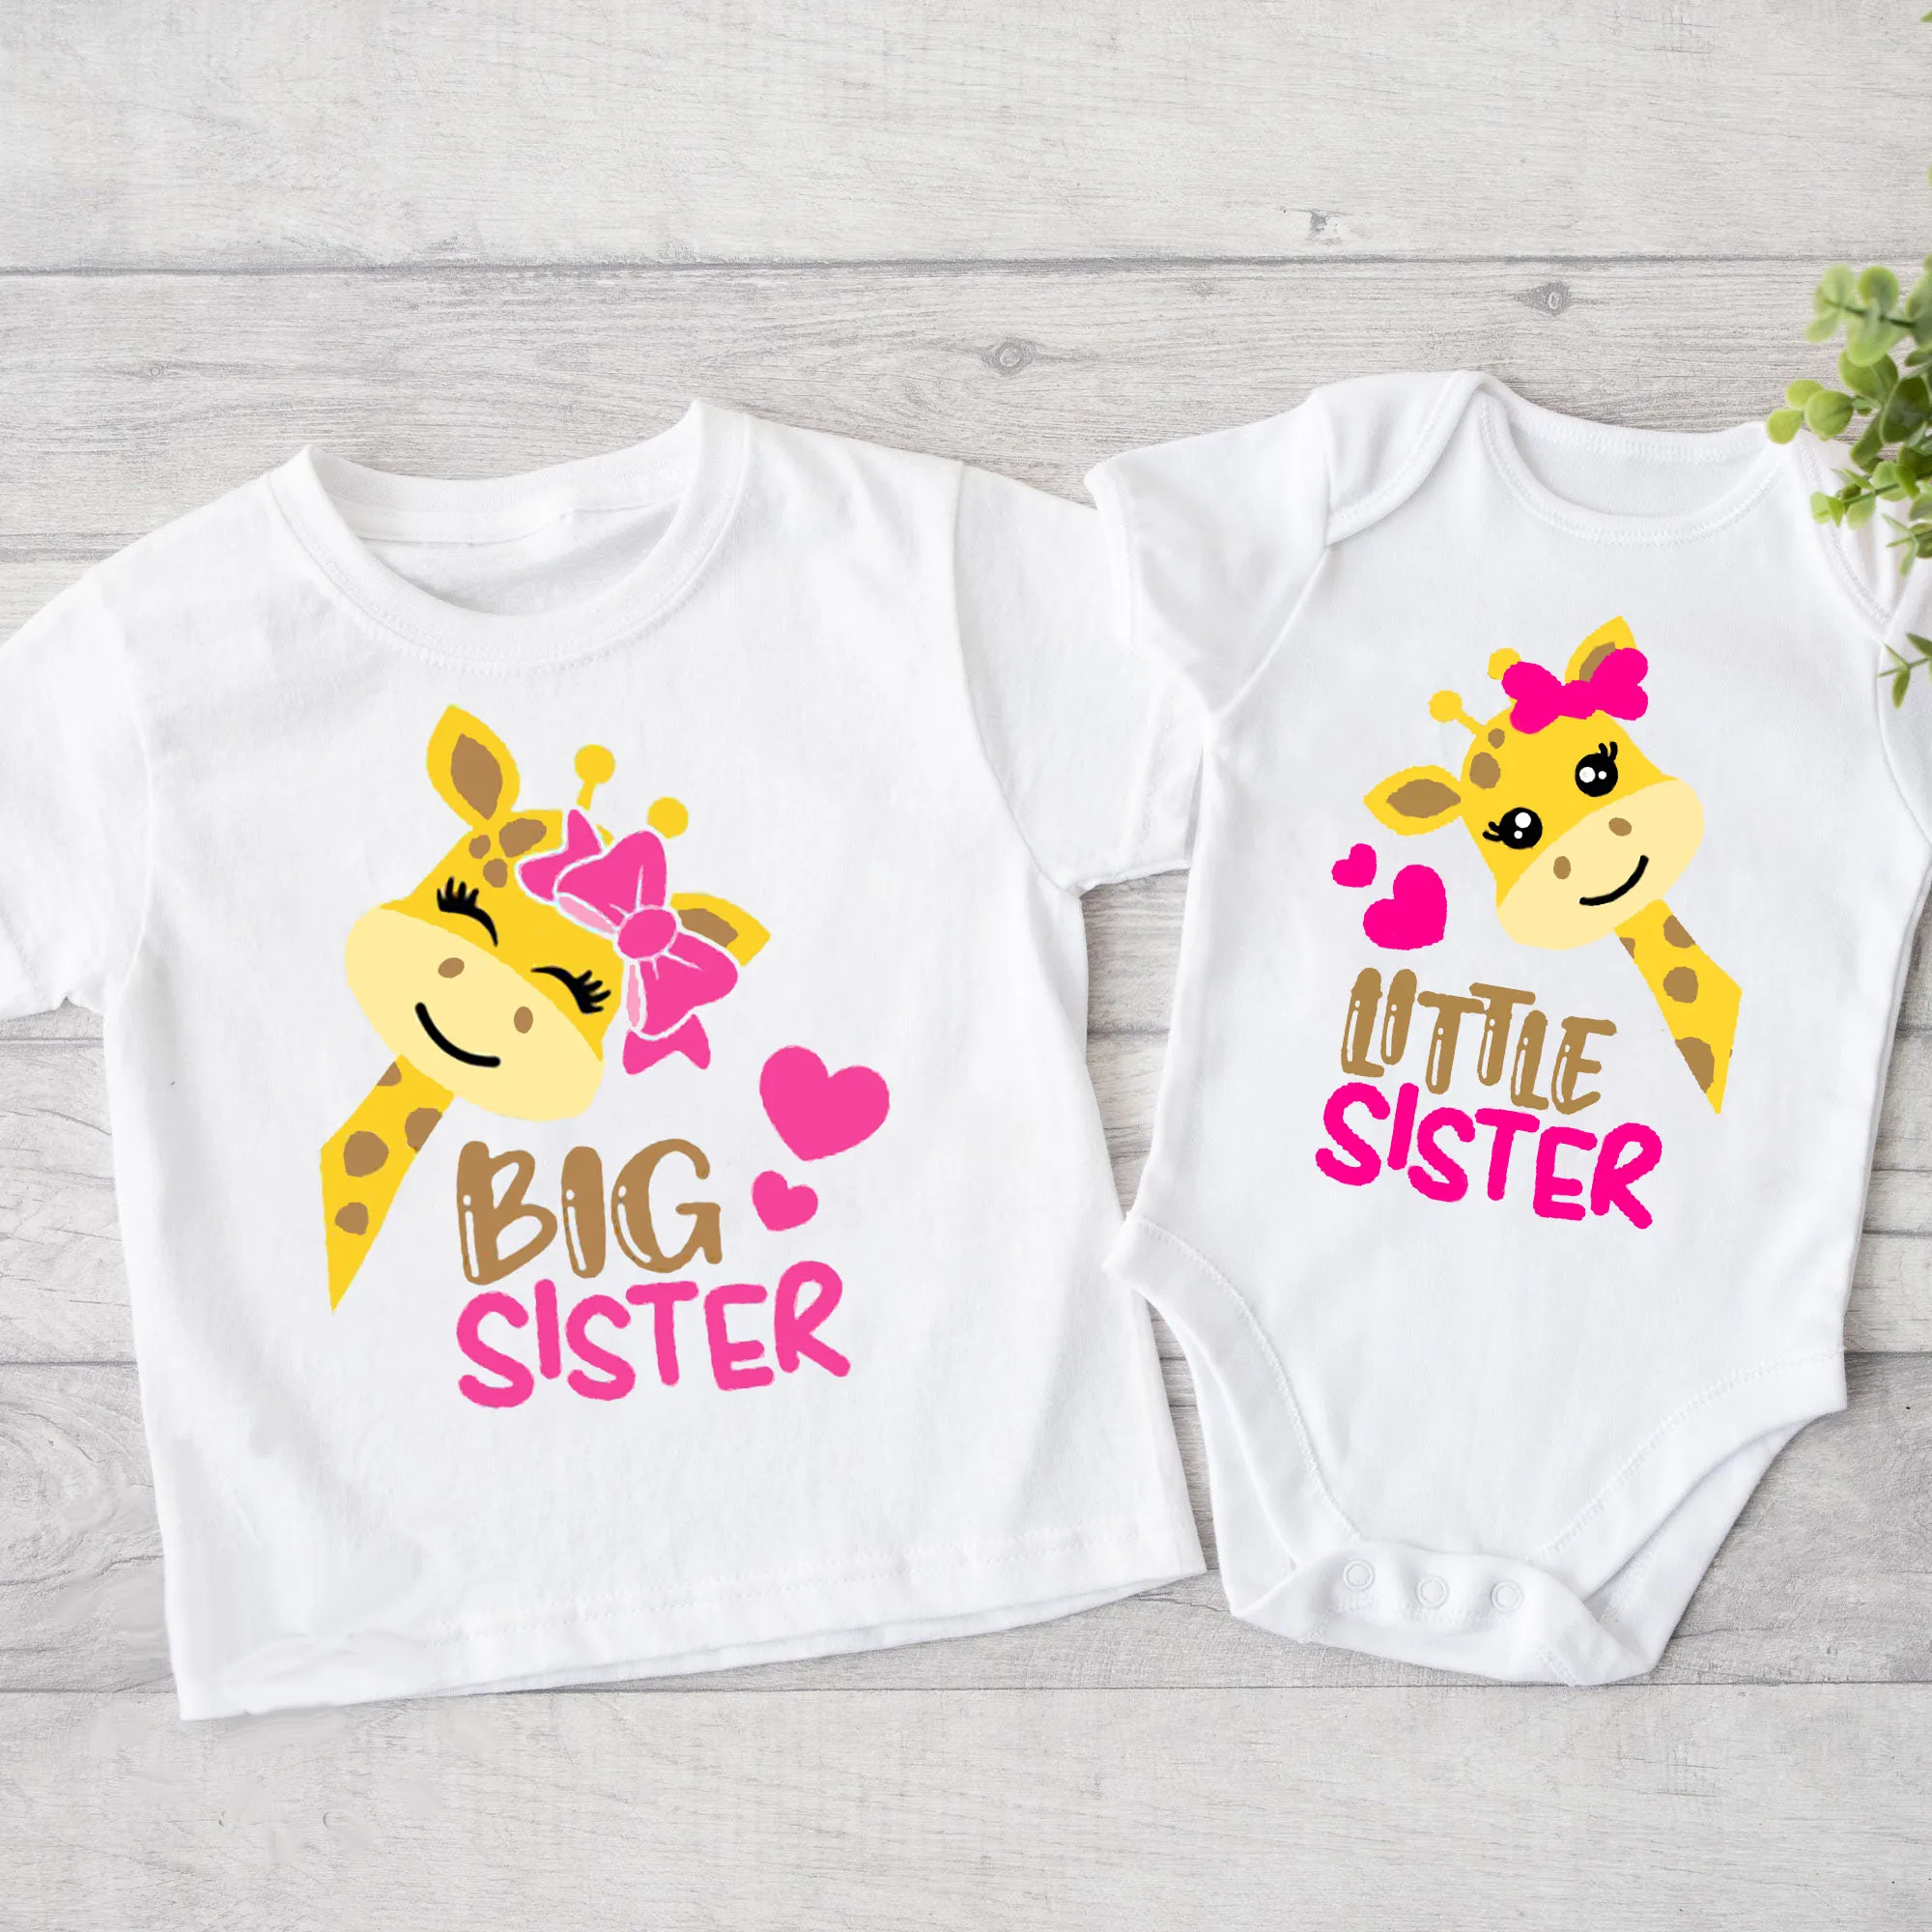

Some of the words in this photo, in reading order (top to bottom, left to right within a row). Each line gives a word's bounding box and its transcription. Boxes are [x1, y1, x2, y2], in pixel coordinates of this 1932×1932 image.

[1341, 967, 1618, 1116] LITTLE
[456, 1138, 723, 1286] BIG
[1315, 1081, 1663, 1231] SISTER
[456, 1261, 852, 1409] SISTER
